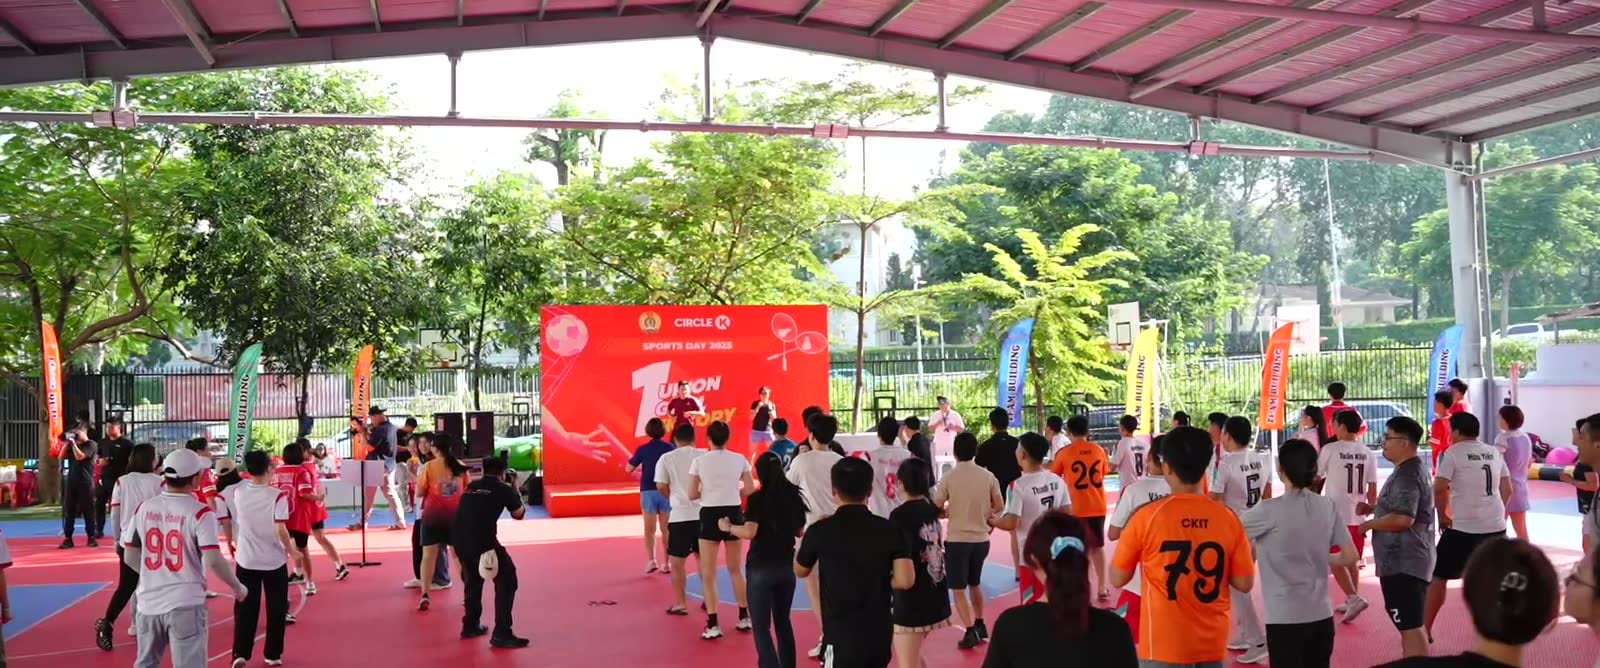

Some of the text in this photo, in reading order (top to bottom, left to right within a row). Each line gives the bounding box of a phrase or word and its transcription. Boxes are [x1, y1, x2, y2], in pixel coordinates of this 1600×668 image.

[674, 318, 713, 328] CIRCLE
[643, 341, 733, 350] SPORTS DAY 2025
[1008, 344, 1020, 392] BUILDING
[1135, 355, 1146, 402] BUILDING
[1438, 348, 1449, 391] UILDING
[659, 376, 721, 399] UNON
[1267, 348, 1282, 423] TEAM BUILDING
[235, 374, 250, 464] TEAM BUILDING
[886, 472, 897, 499] 8
[1071, 460, 1102, 490] 26
[1246, 473, 1260, 508] 6
[1344, 463, 1364, 494] 11
[1481, 464, 1493, 496] 1
[1181, 518, 1209, 528] CKIT
[144, 527, 184, 573] 99
[1160, 540, 1225, 604] 79
